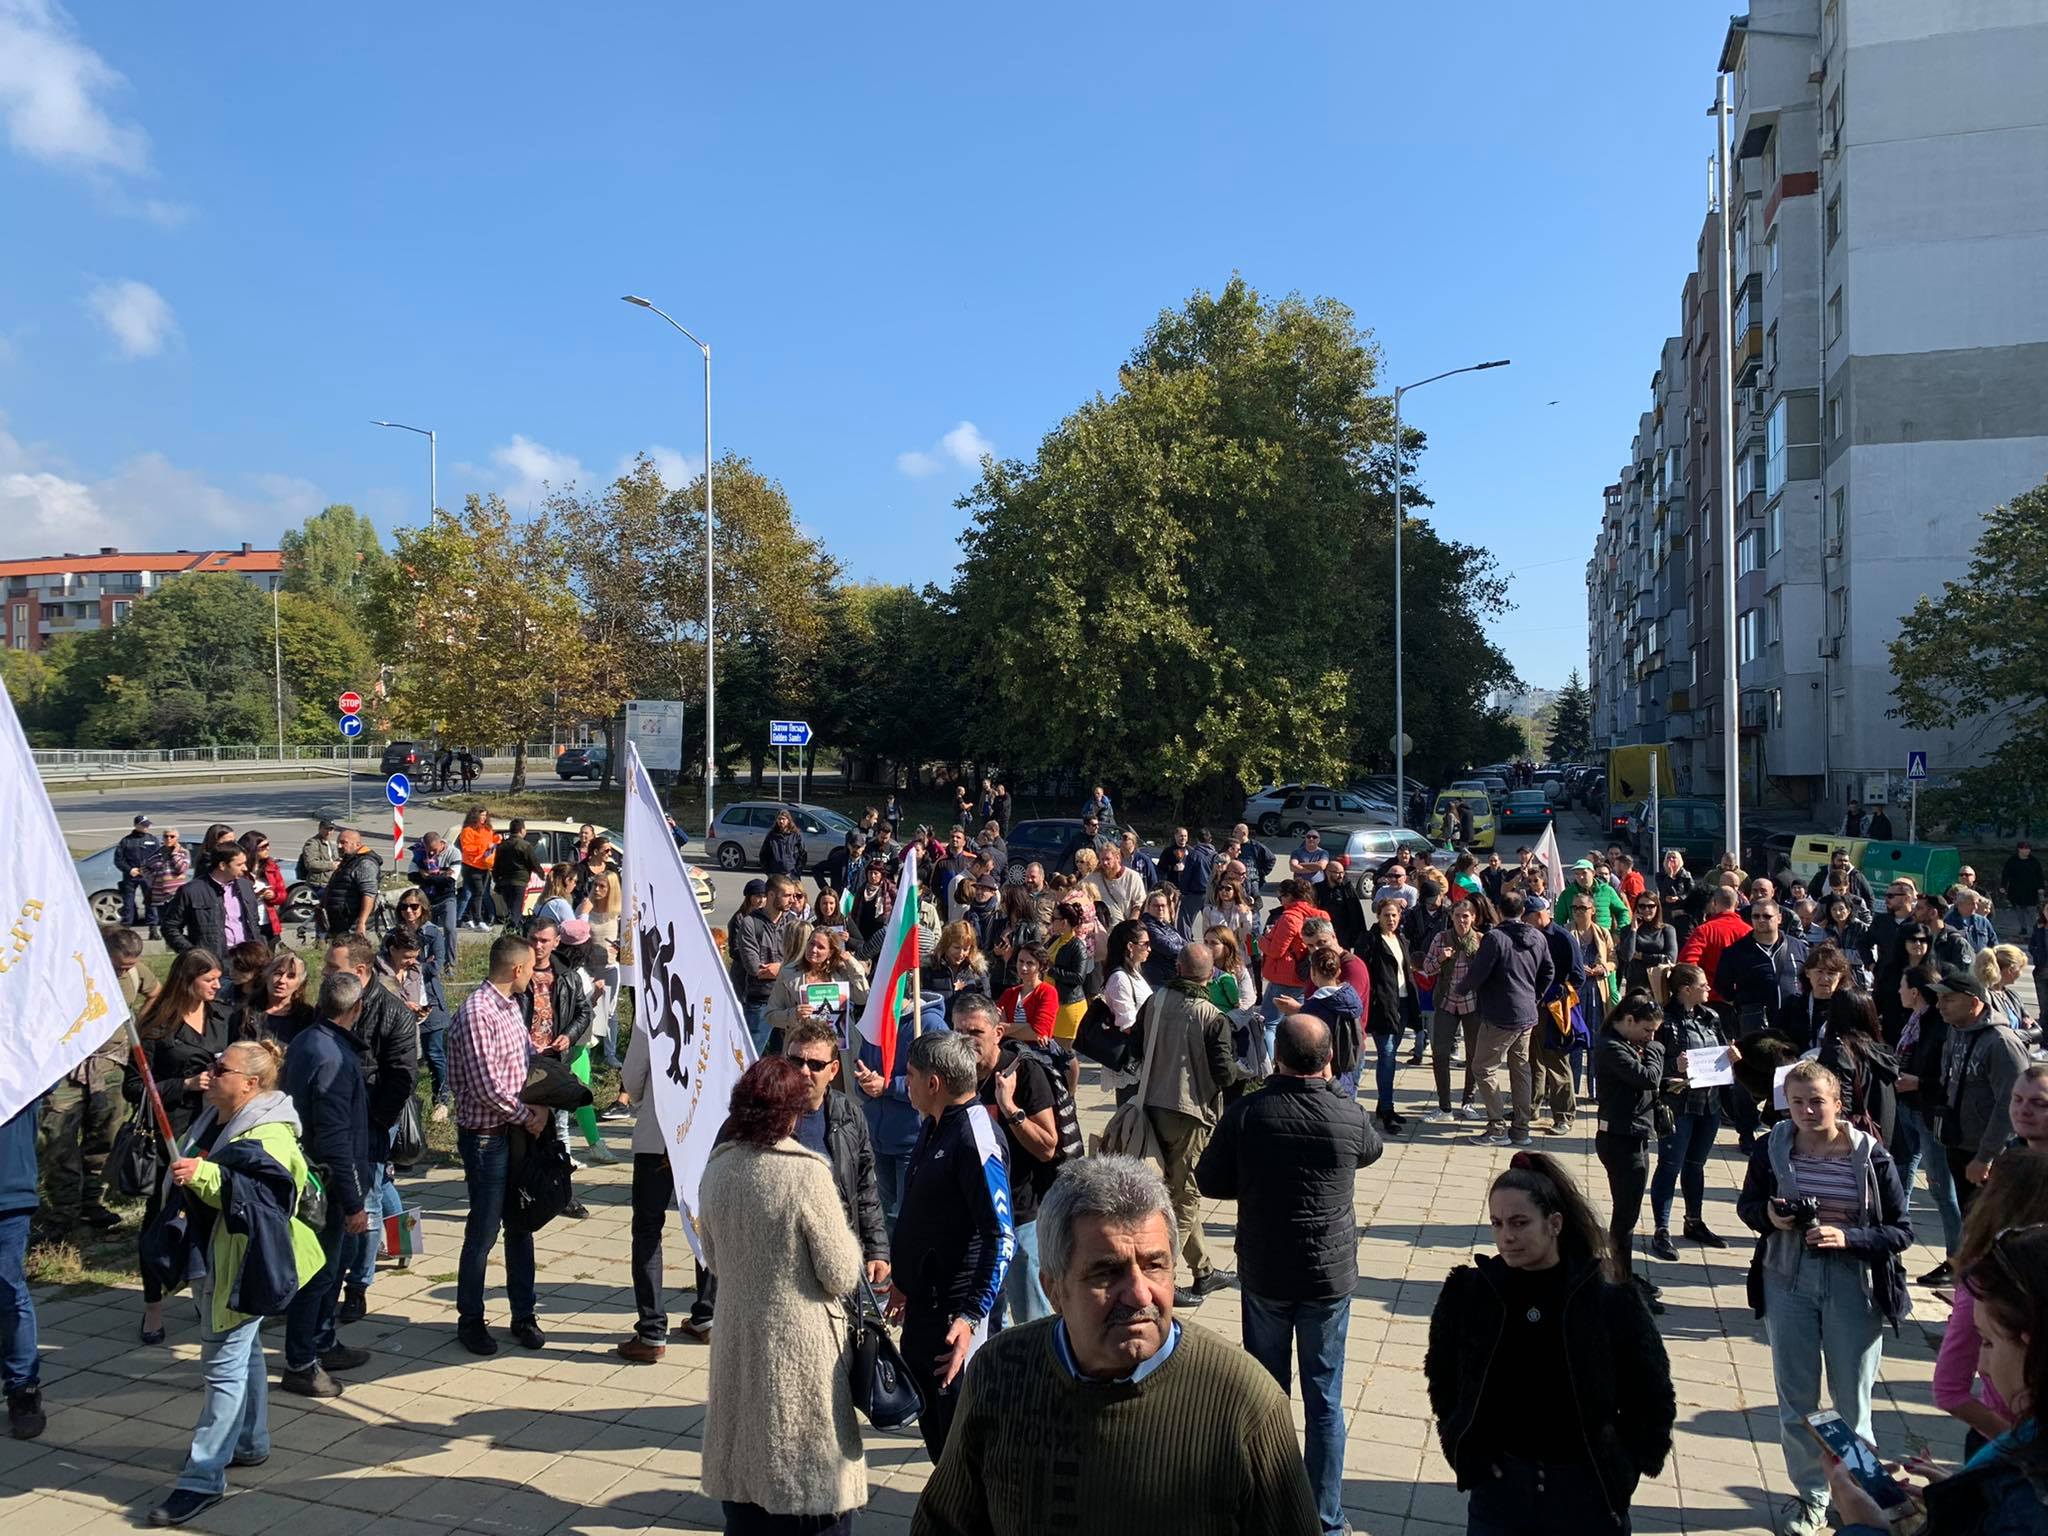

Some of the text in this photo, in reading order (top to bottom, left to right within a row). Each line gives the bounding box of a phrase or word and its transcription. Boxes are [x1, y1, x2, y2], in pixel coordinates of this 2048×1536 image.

[341, 699, 360, 708] STOP
[772, 733, 802, 742] Golden Sands
